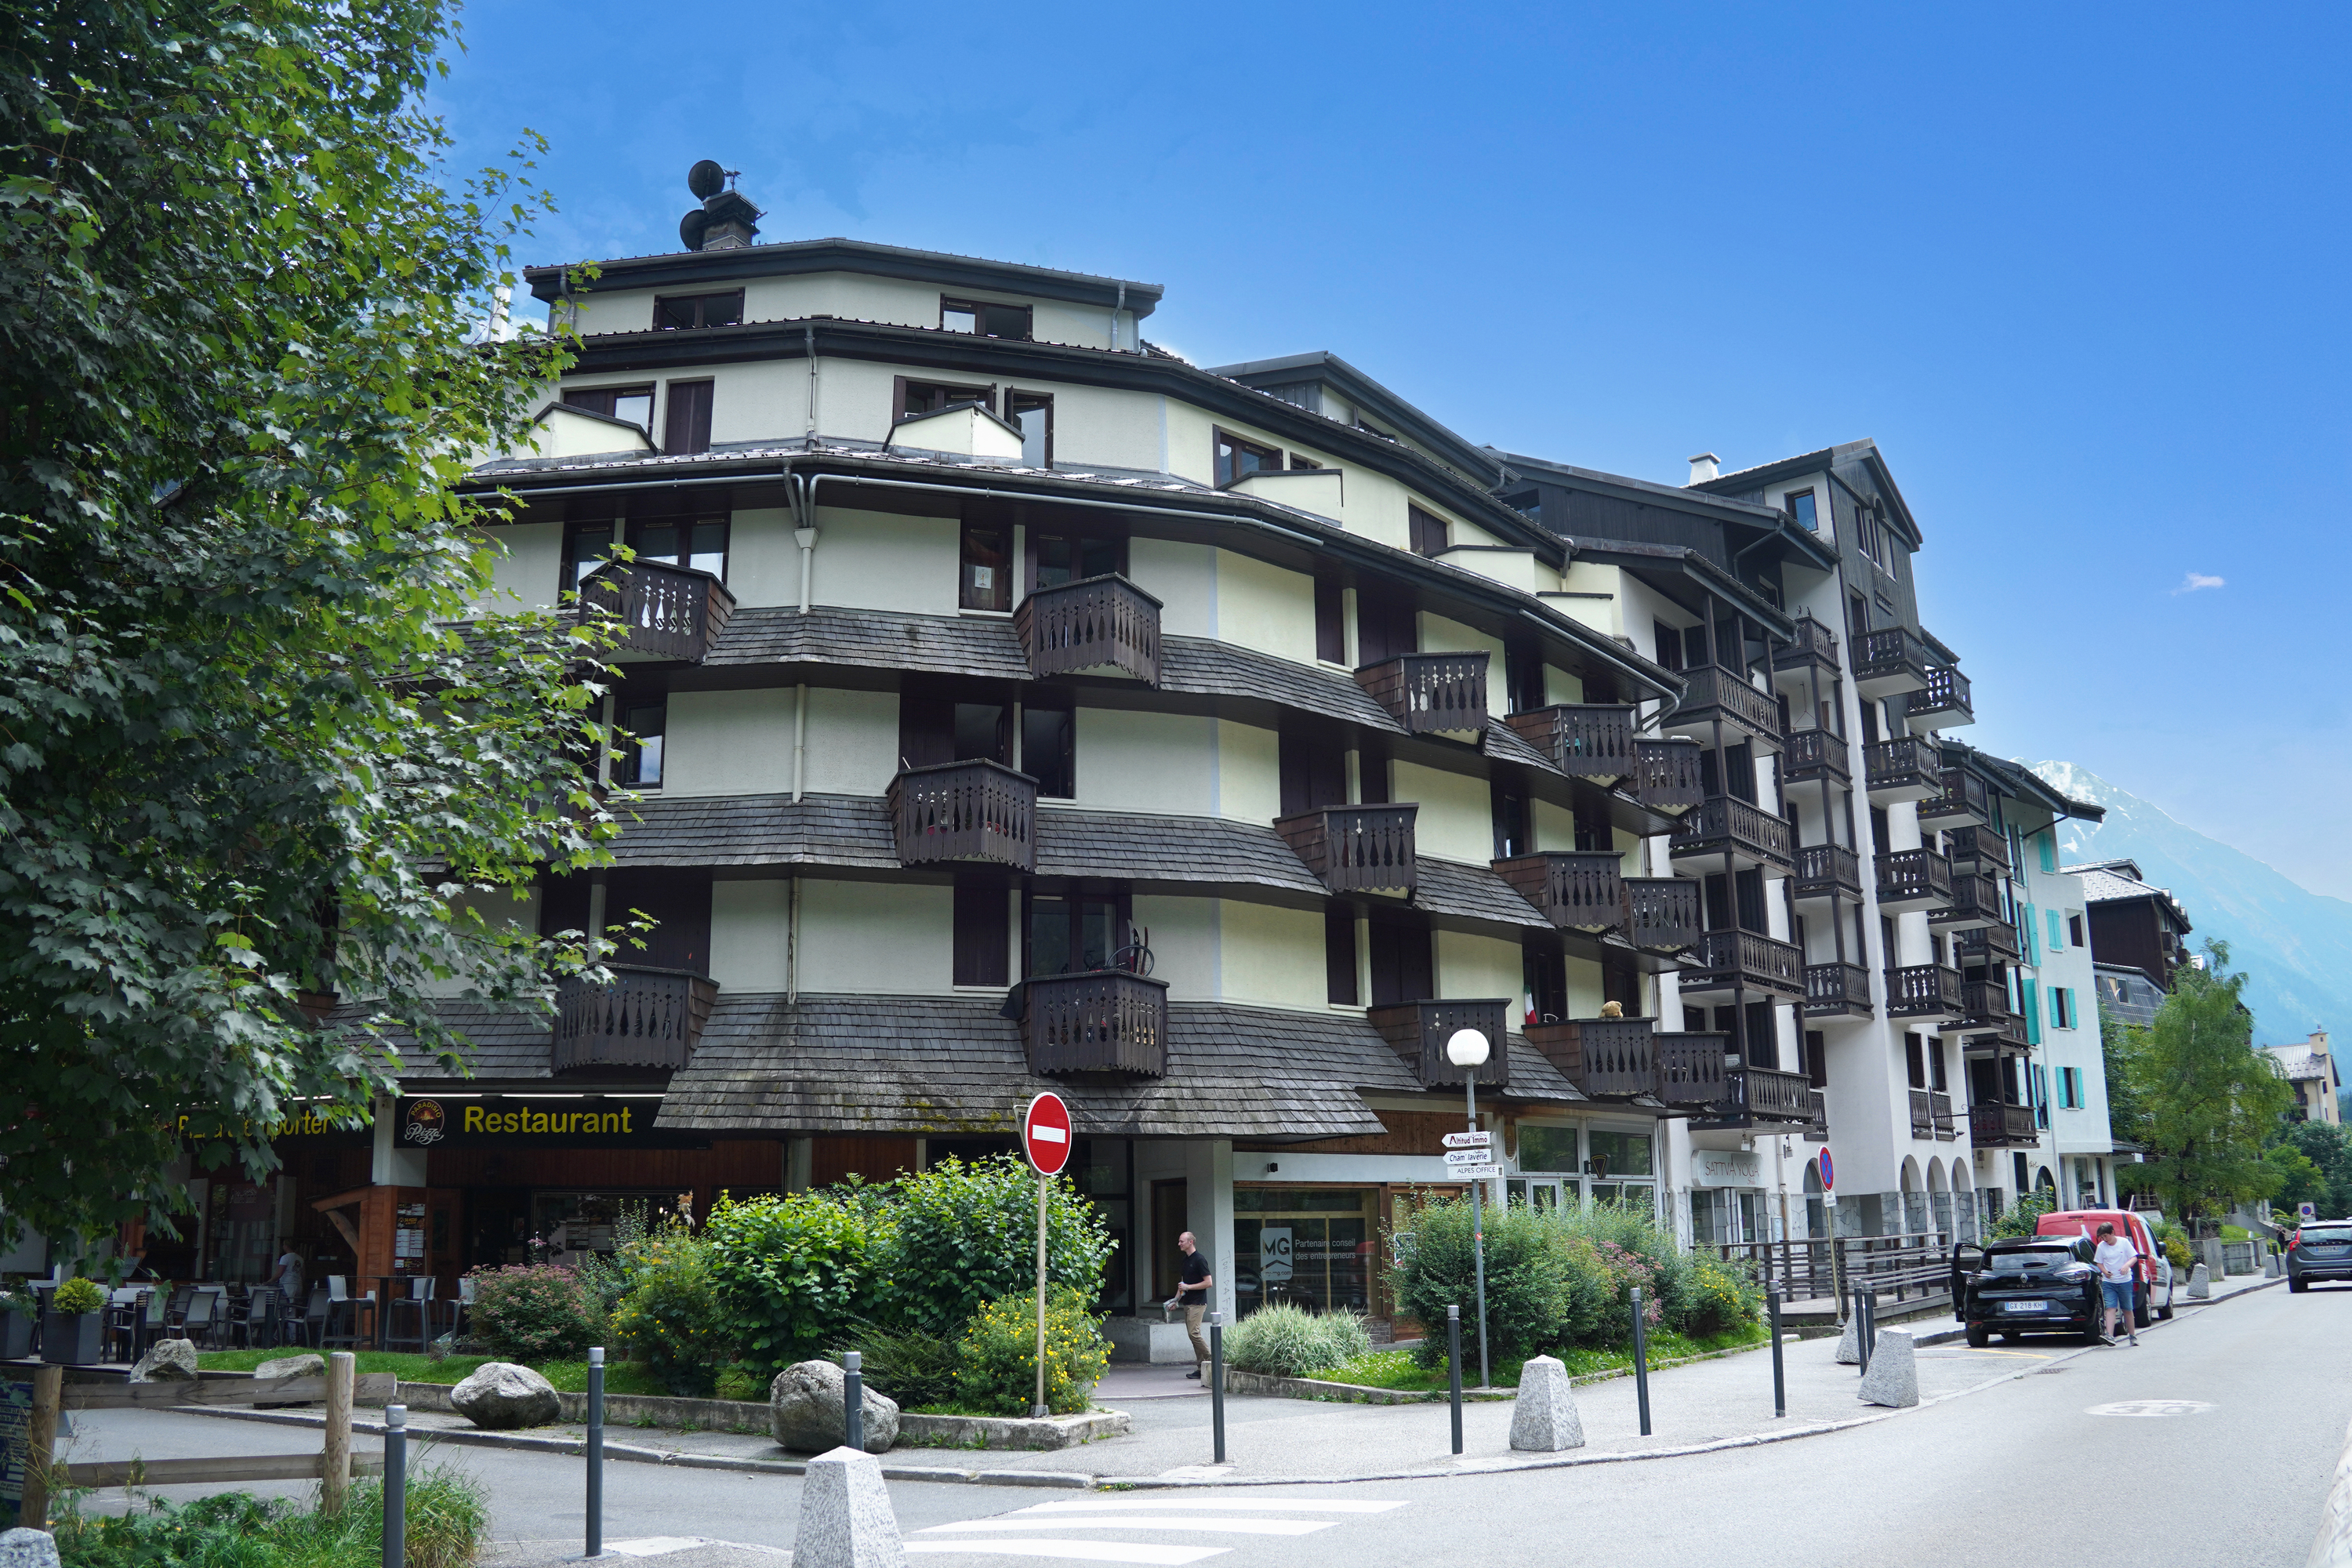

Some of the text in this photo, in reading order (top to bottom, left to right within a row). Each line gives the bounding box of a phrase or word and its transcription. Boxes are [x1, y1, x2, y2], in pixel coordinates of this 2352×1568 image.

[411, 1102, 441, 1118] PARADISIO
[464, 1106, 633, 1133] Restaurant
[405, 1122, 445, 1145] Pizza
[1705, 1160, 1760, 1178] SATTVA YOGA
[1262, 1237, 1290, 1255] MG
[1295, 1238, 1356, 1247] Partenaire conseil
[1295, 1251, 1356, 1261] des entrepreneurs
